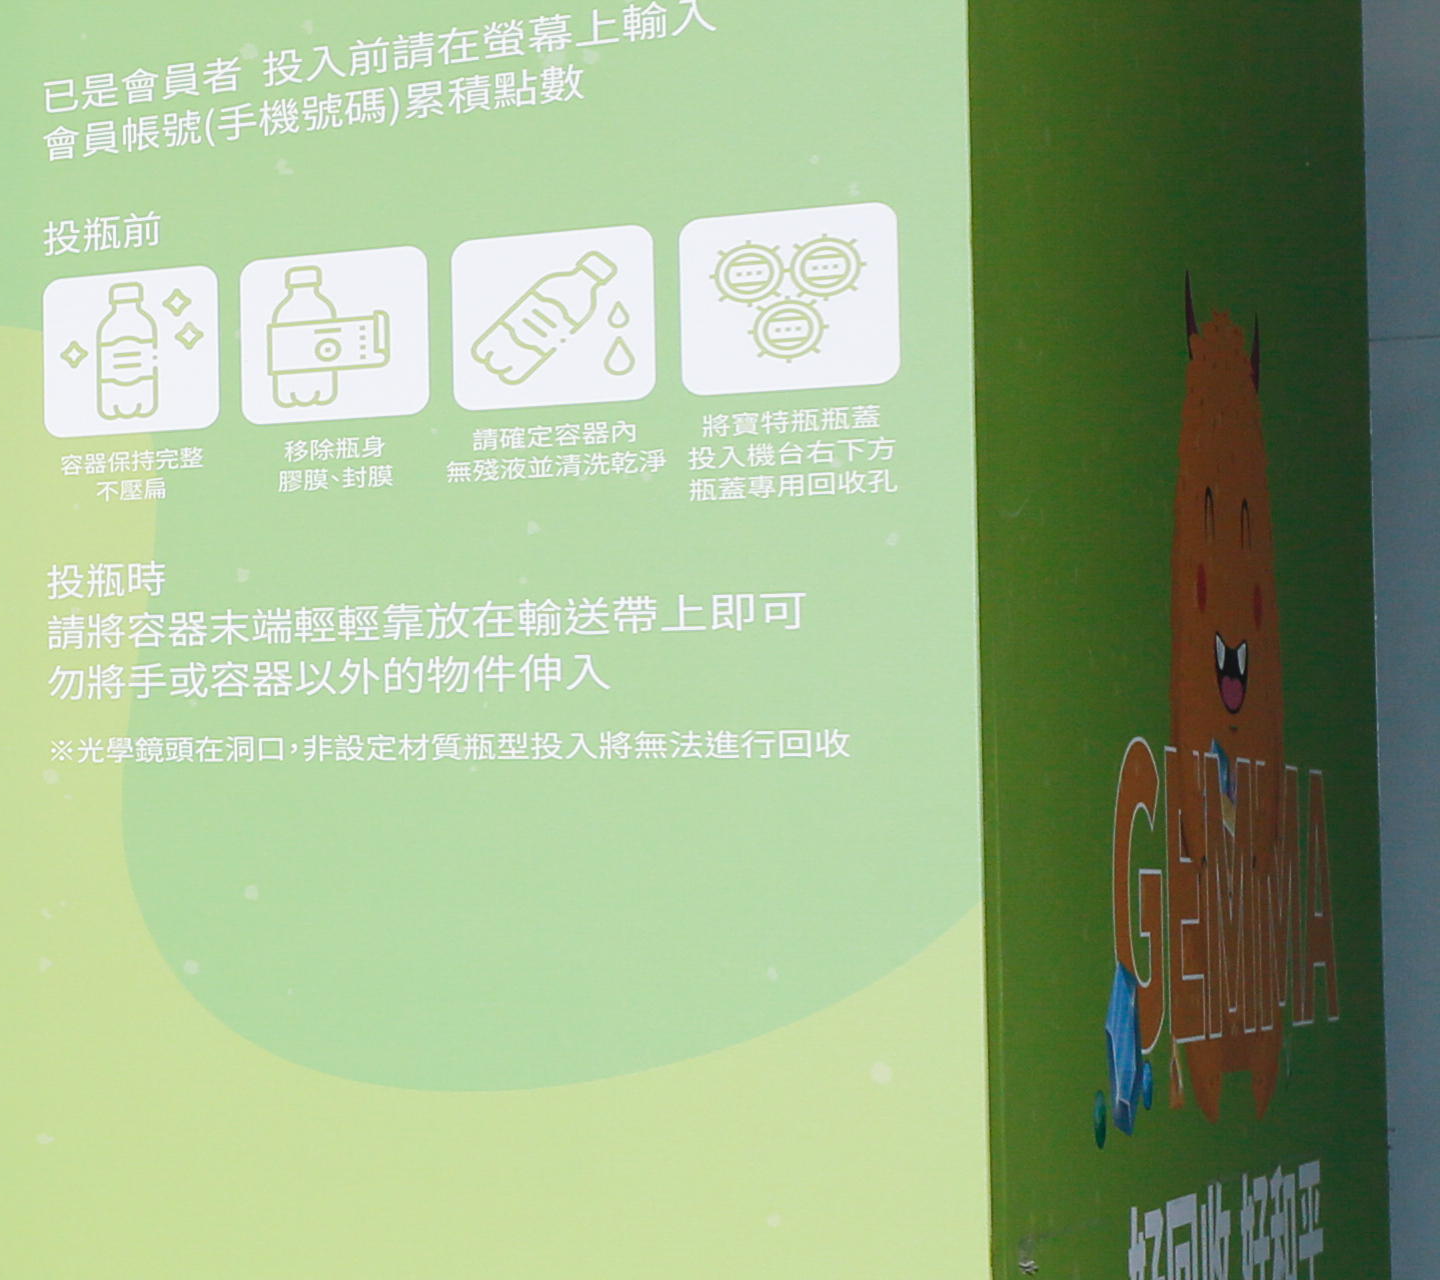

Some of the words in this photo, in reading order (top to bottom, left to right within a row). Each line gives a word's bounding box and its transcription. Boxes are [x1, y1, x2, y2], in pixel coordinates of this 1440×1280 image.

[43, 55, 243, 118] 已是會員者
[43, 63, 585, 163] 會員帳號(手機號碼)累積點數
[43, 210, 162, 258] 投瓶前
[472, 420, 637, 452] 請確定容器內
[702, 404, 881, 438] 將寶特瓶瓶蓋
[60, 446, 204, 477] 容器保持完整
[284, 434, 386, 464] 移除瓶身
[446, 448, 667, 484] 無殘液並清洗乾淨
[688, 437, 897, 471] 投入機台右下方
[96, 478, 167, 503] 不壓扁
[278, 464, 394, 493] 膠膜、封膜
[689, 469, 898, 502] 瓶蓋專用回收孔
[47, 560, 166, 602] 投瓶時
[47, 590, 807, 653] 請將容器末端輕輕靠放在輸送帶上即可
[49, 654, 612, 701] 勿將手或容器以外的物件伸入
[1113, 734, 1341, 1056] GEMMA
